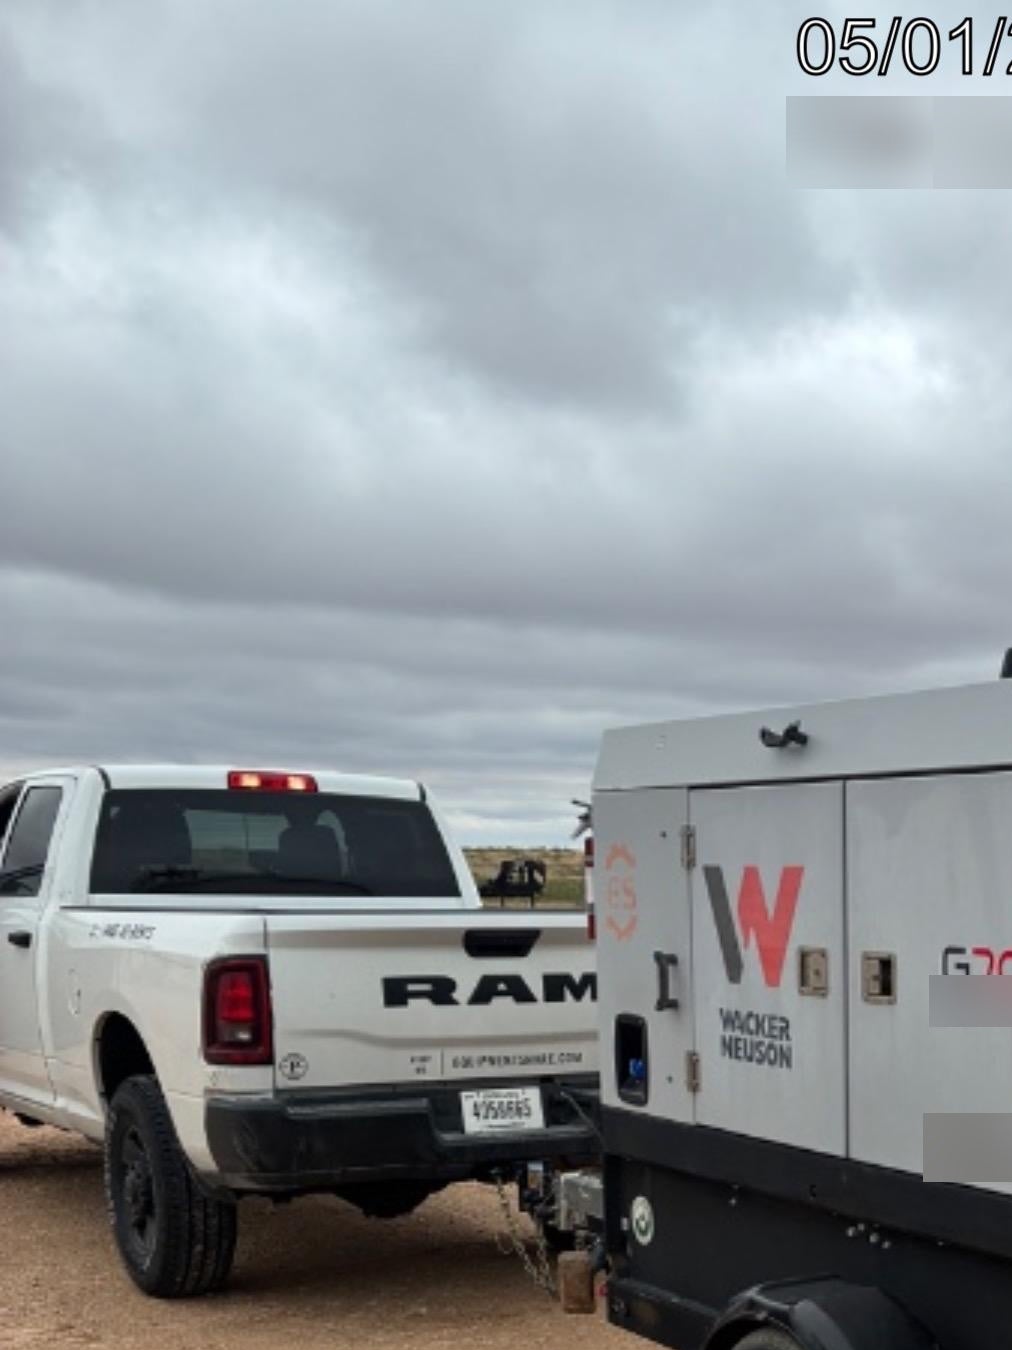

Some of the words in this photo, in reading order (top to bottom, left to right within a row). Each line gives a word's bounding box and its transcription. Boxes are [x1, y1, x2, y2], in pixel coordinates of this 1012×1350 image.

[382, 972, 597, 1008] RAM
[719, 1007, 791, 1042] WACKER
[720, 1034, 792, 1070] NEUSON
